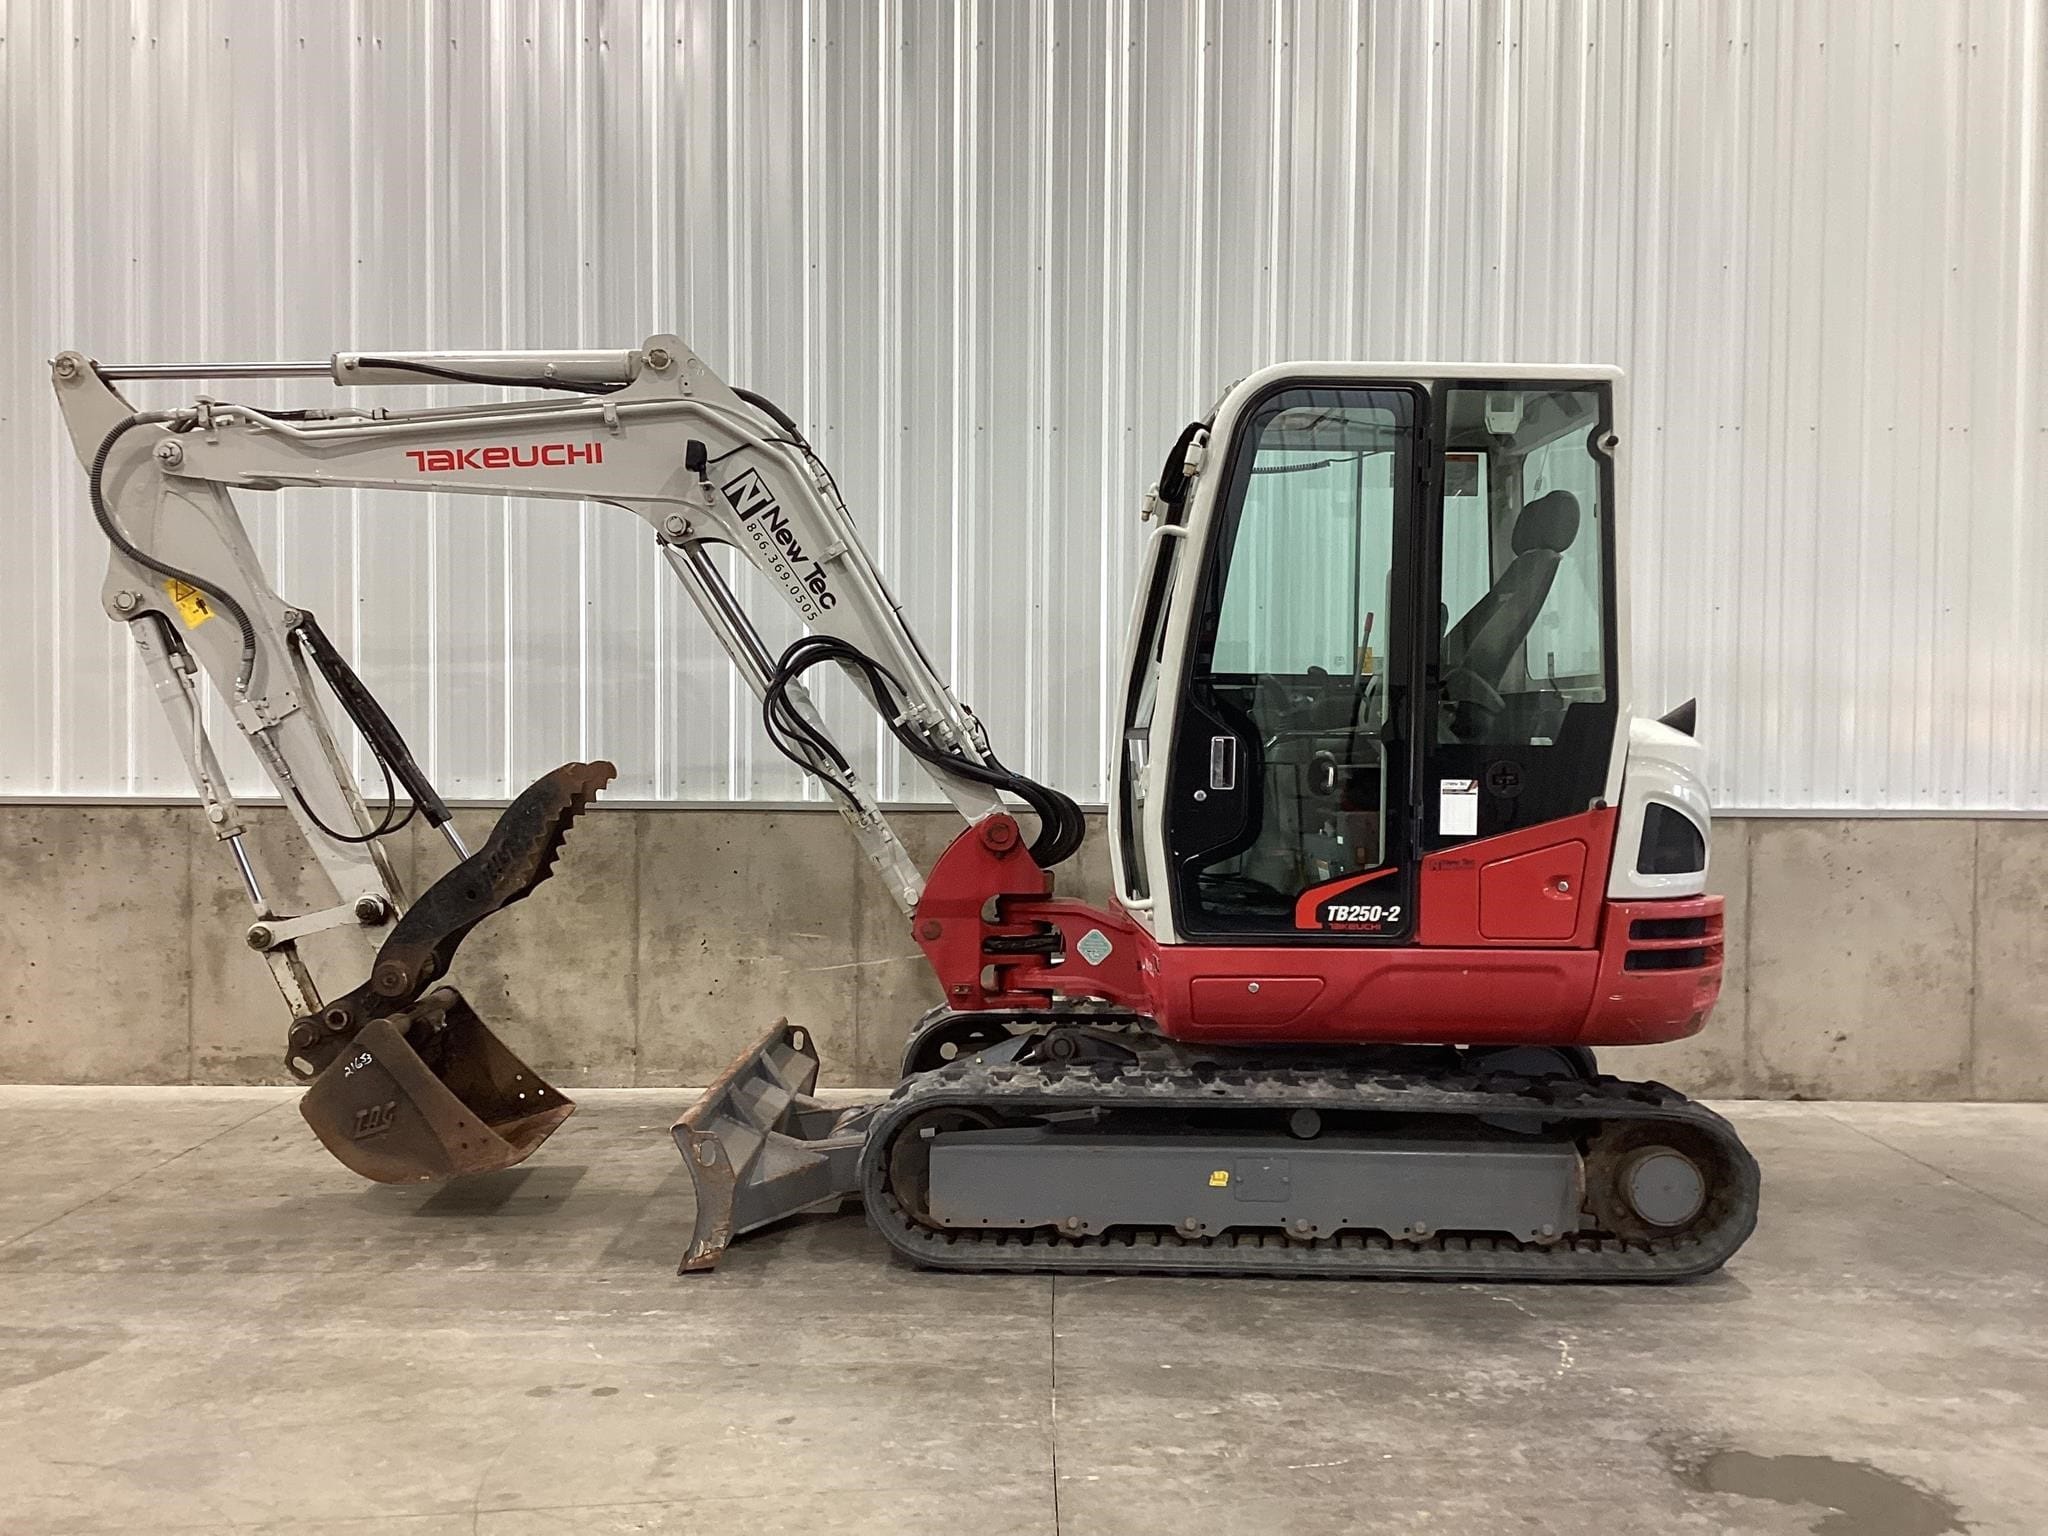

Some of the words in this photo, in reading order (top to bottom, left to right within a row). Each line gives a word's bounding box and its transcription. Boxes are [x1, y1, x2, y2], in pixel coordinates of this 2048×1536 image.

[406, 442, 603, 472] TAKEUCHI
[746, 522, 818, 621] 866.369.0505
[761, 505, 810, 564] New
[803, 561, 837, 610] Tec
[1327, 905, 1401, 922] TB250-2
